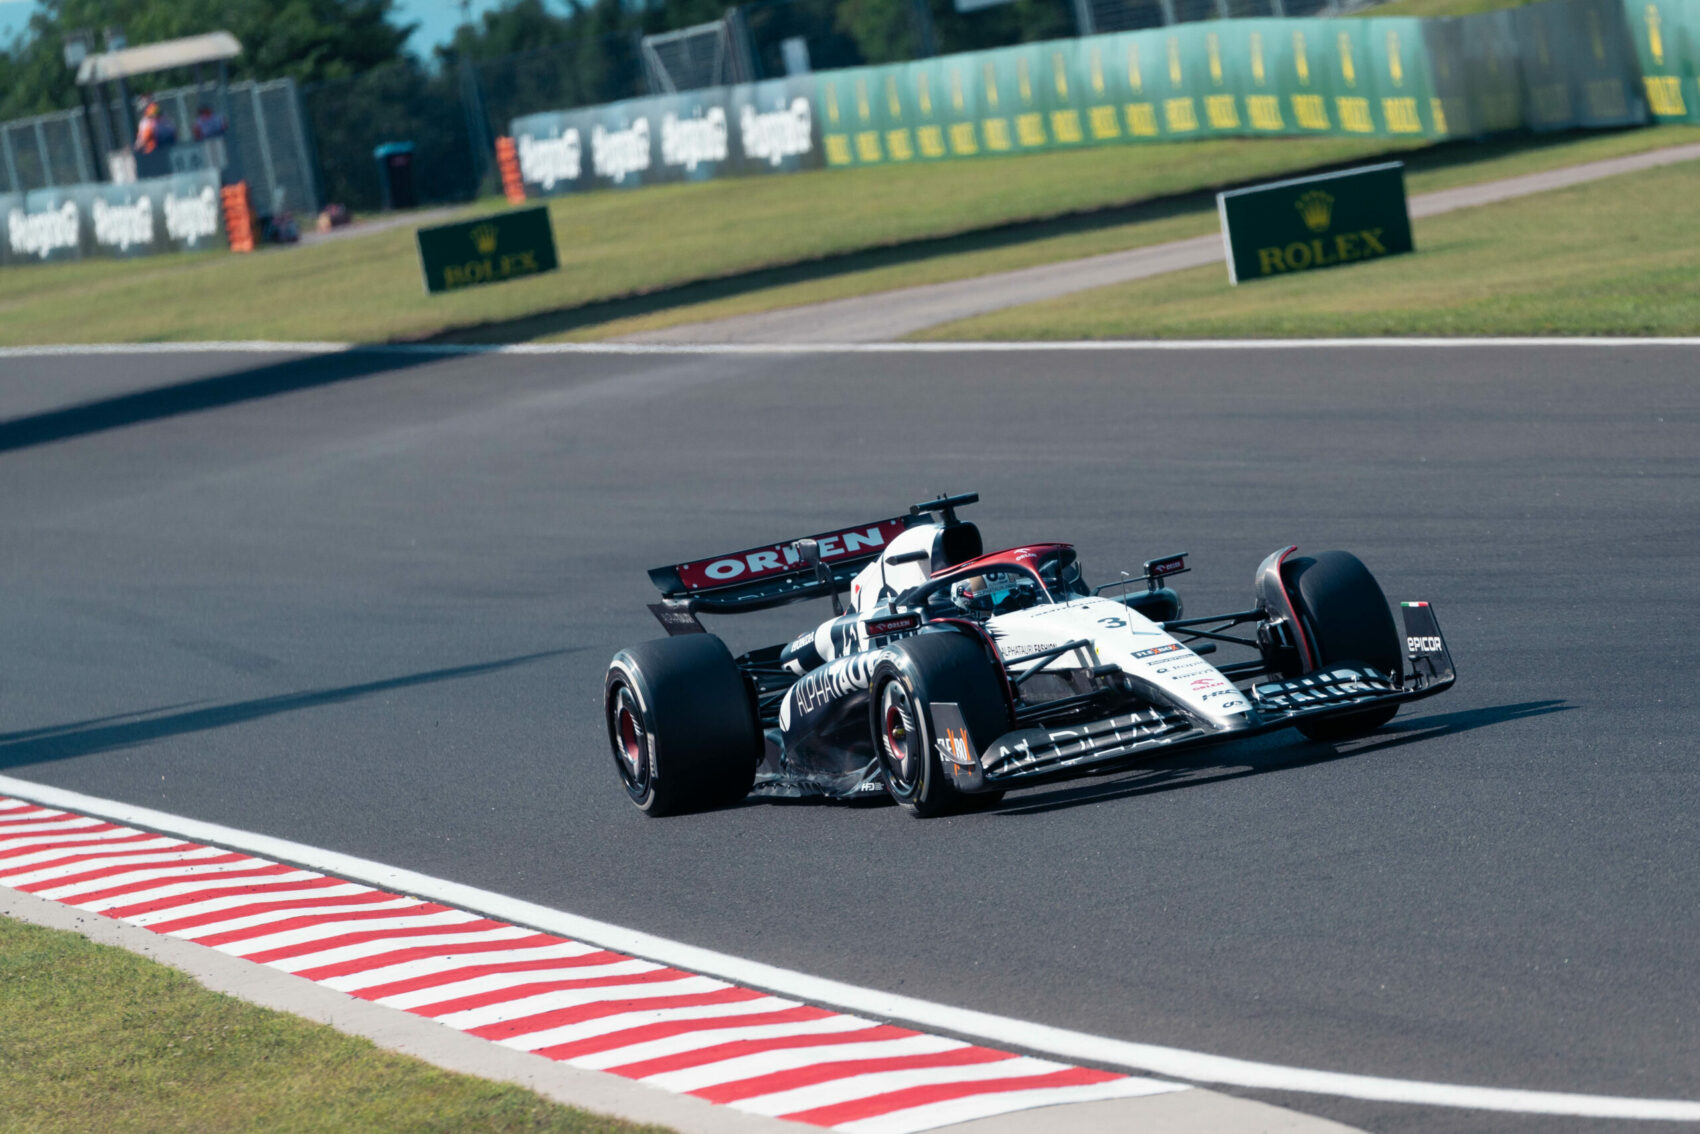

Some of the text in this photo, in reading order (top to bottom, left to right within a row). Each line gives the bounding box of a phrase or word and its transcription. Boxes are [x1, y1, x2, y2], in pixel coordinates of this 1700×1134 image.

[444, 249, 538, 289] ROLEX
[1258, 227, 1386, 275] ROLEX
[704, 527, 885, 580] ORLEN
[1097, 617, 1127, 629] 3
